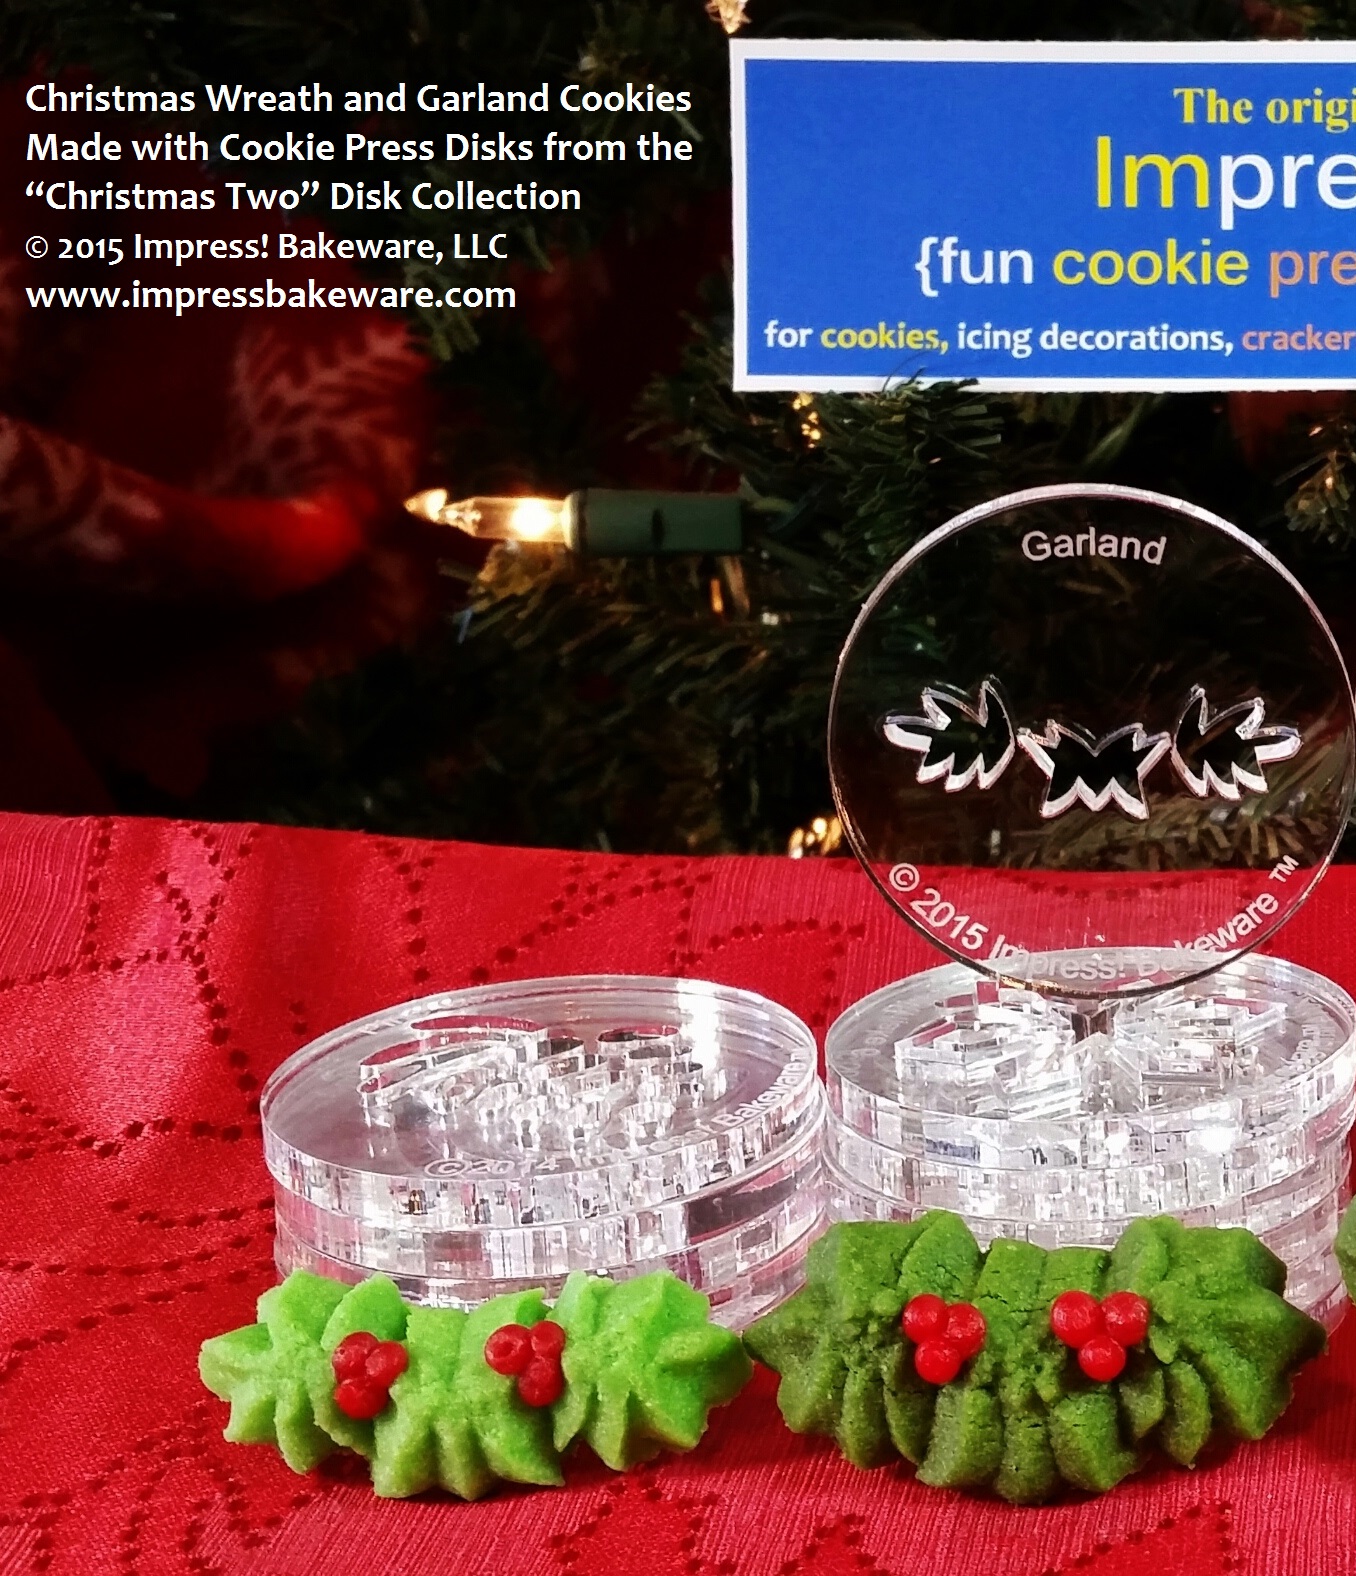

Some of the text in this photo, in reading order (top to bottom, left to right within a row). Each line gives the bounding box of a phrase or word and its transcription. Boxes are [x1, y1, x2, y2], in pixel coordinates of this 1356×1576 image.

[1173, 87, 1254, 125] The
[914, 236, 1034, 298] {fun
[1053, 238, 1250, 286] cookie
[764, 320, 814, 349] for
[821, 322, 950, 355] cookies,
[958, 323, 1034, 359] icing
[1040, 323, 1235, 358] decorations,
[1021, 526, 1167, 565] Garland
[909, 886, 991, 951] 2015
[988, 932, 1126, 981] Impress!
[710, 1061, 808, 1127] Bakeware
